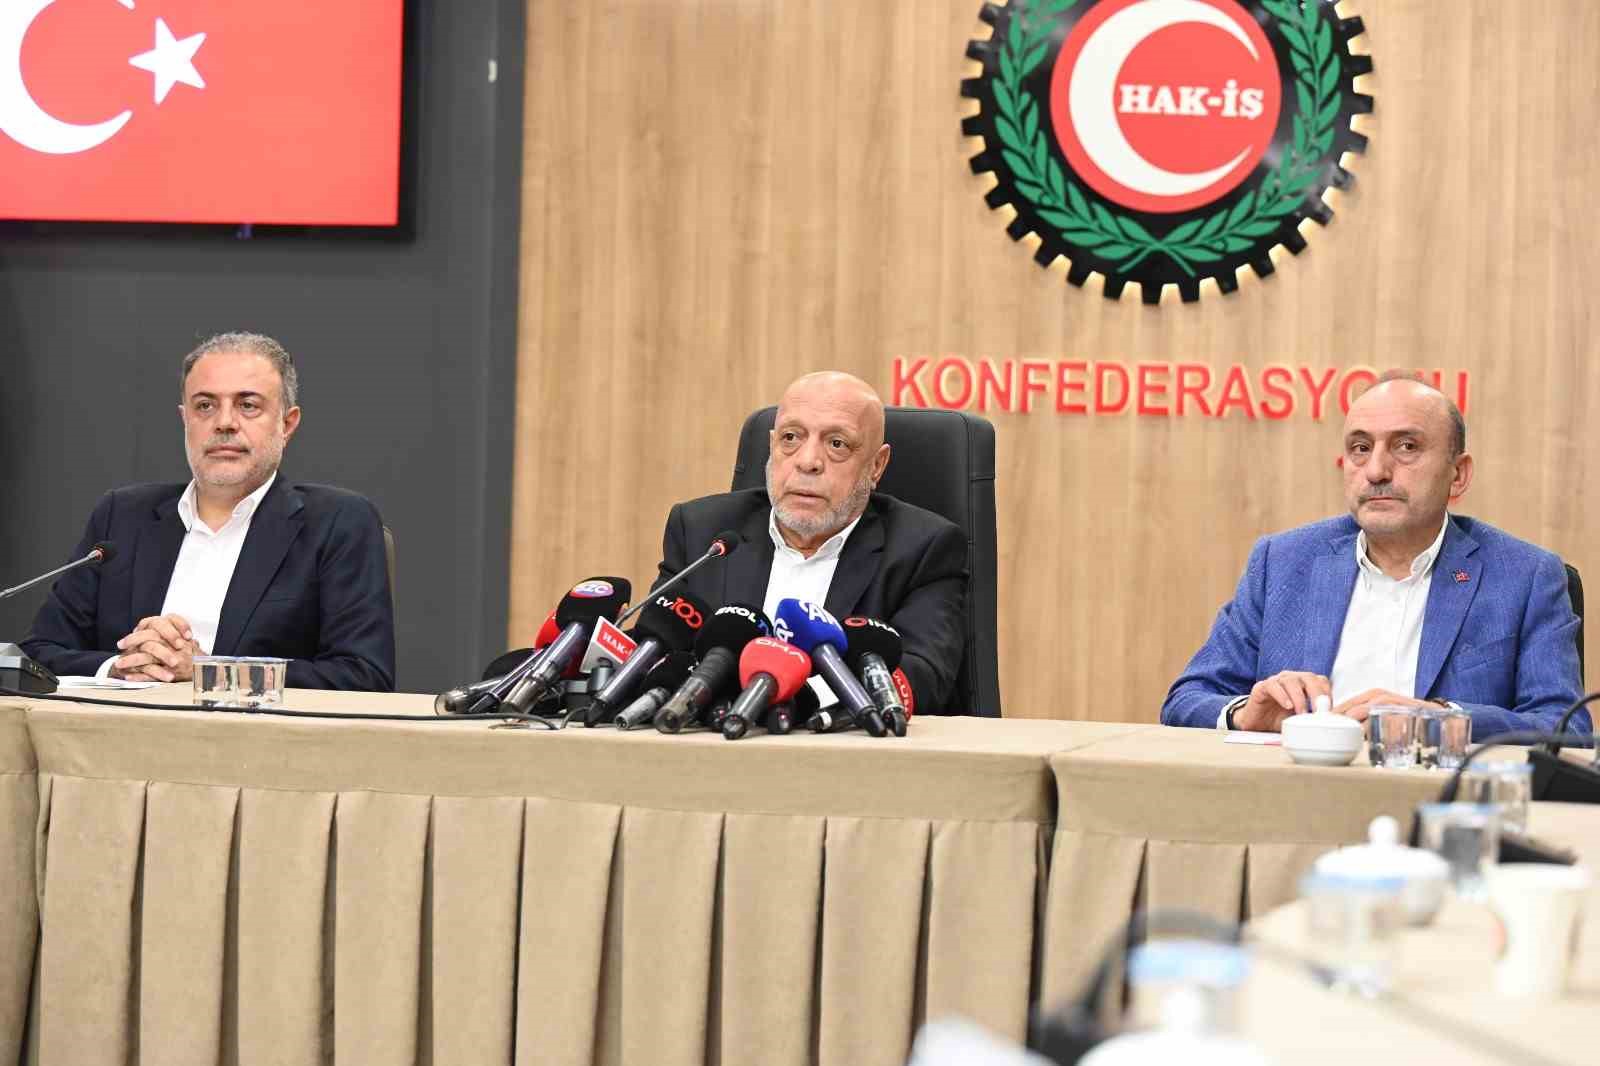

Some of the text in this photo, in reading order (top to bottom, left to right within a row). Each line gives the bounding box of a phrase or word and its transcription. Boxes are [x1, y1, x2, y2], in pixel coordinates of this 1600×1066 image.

[1118, 80, 1265, 119] HAK-İŞ
[892, 357, 1468, 420] KONFEDERASYO
[602, 630, 631, 656] HAK-
